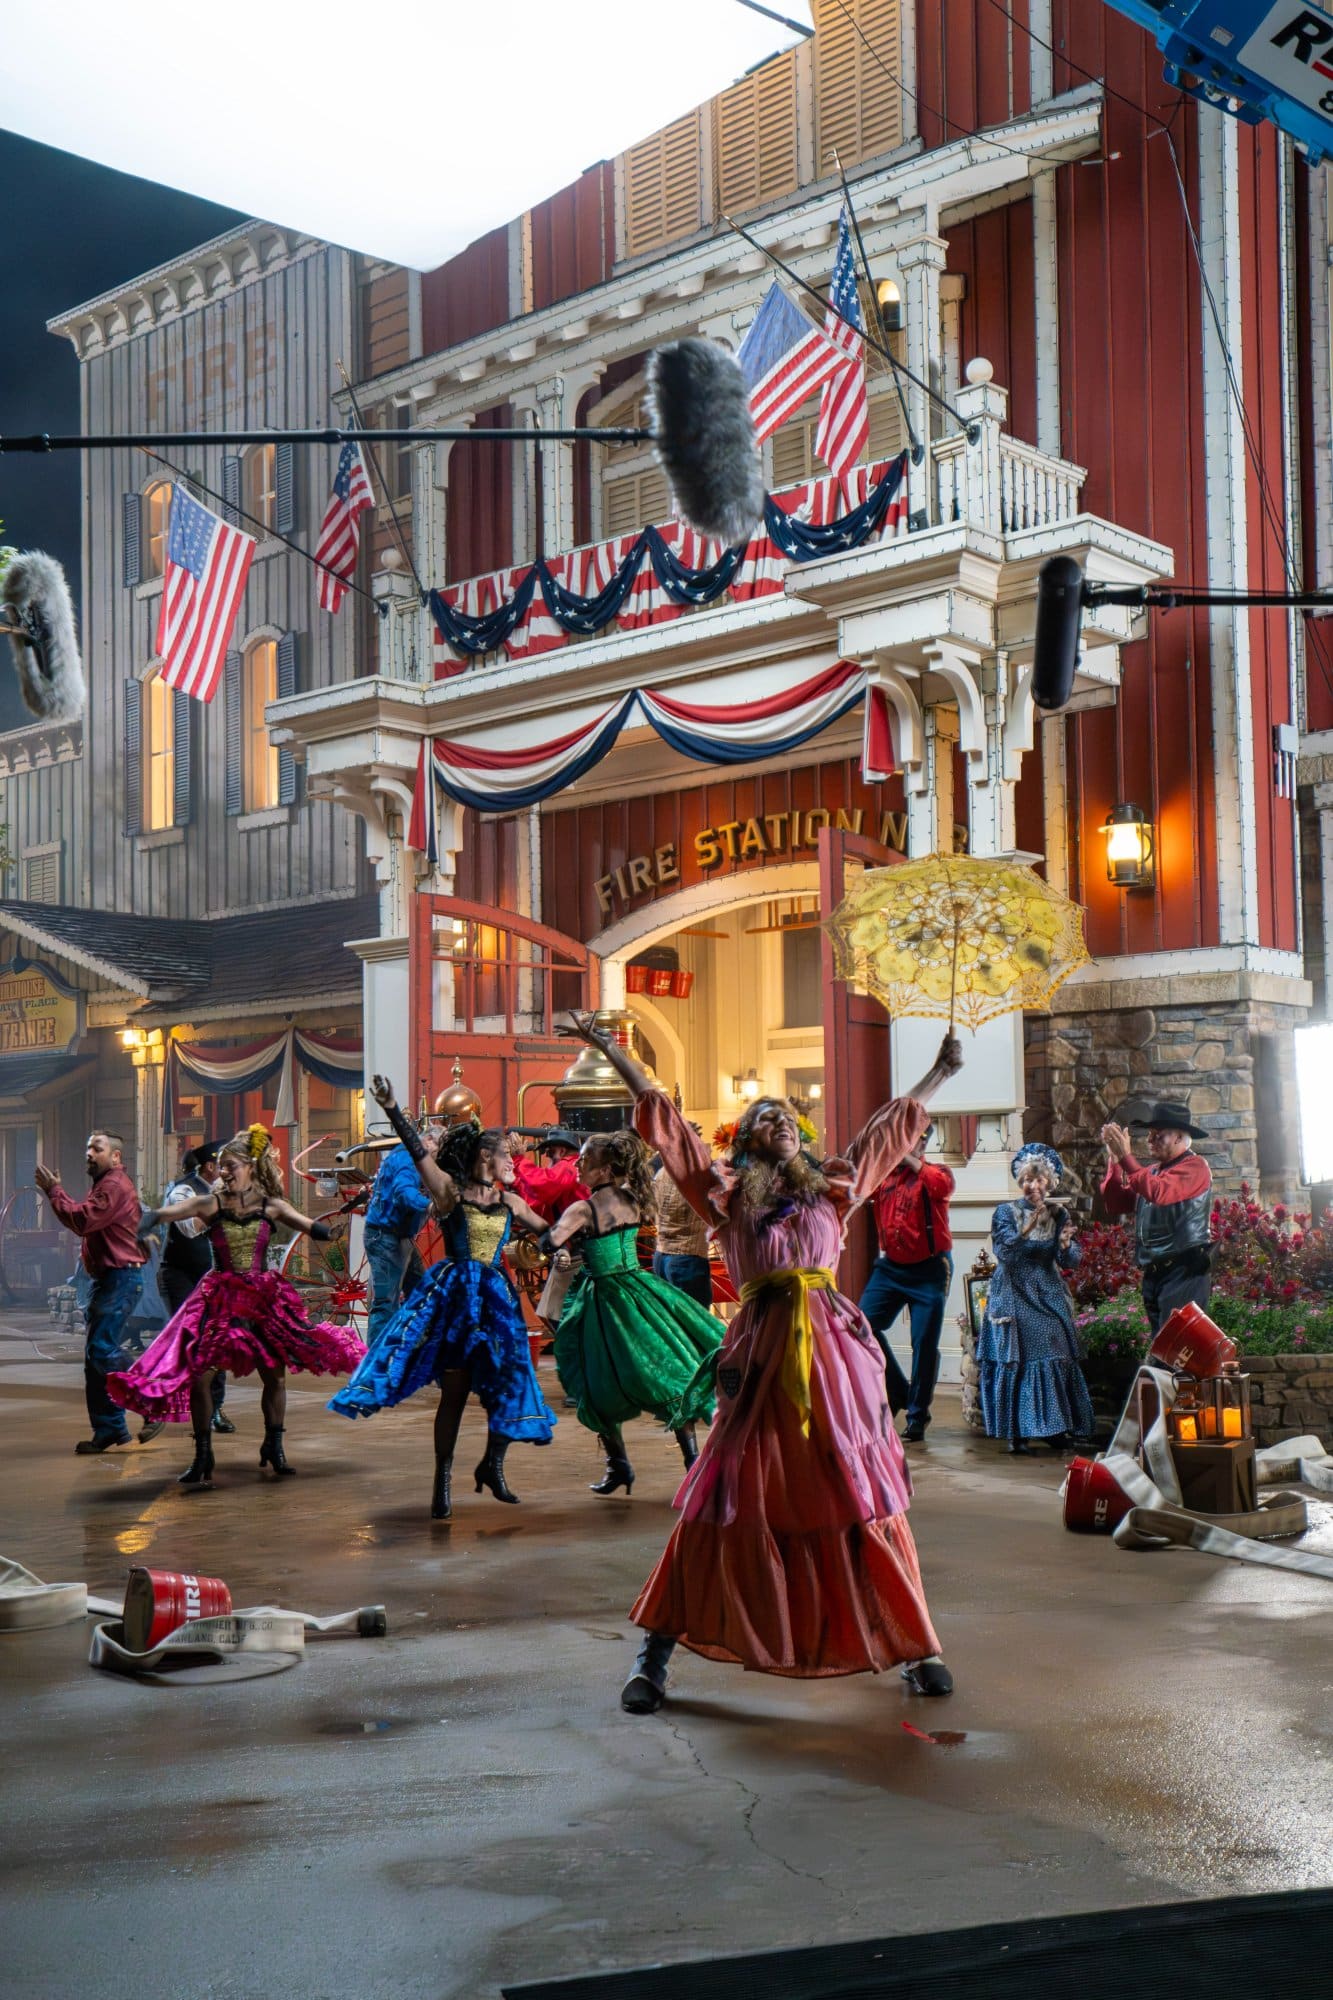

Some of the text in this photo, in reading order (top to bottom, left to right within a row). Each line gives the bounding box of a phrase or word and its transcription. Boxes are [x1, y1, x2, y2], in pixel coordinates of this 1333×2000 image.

[1270, 10, 1333, 65] R
[147, 321, 277, 421] FIRE
[593, 842, 680, 912] FIRE
[694, 807, 864, 866] STATION
[182, 1574, 200, 1623] IRE
